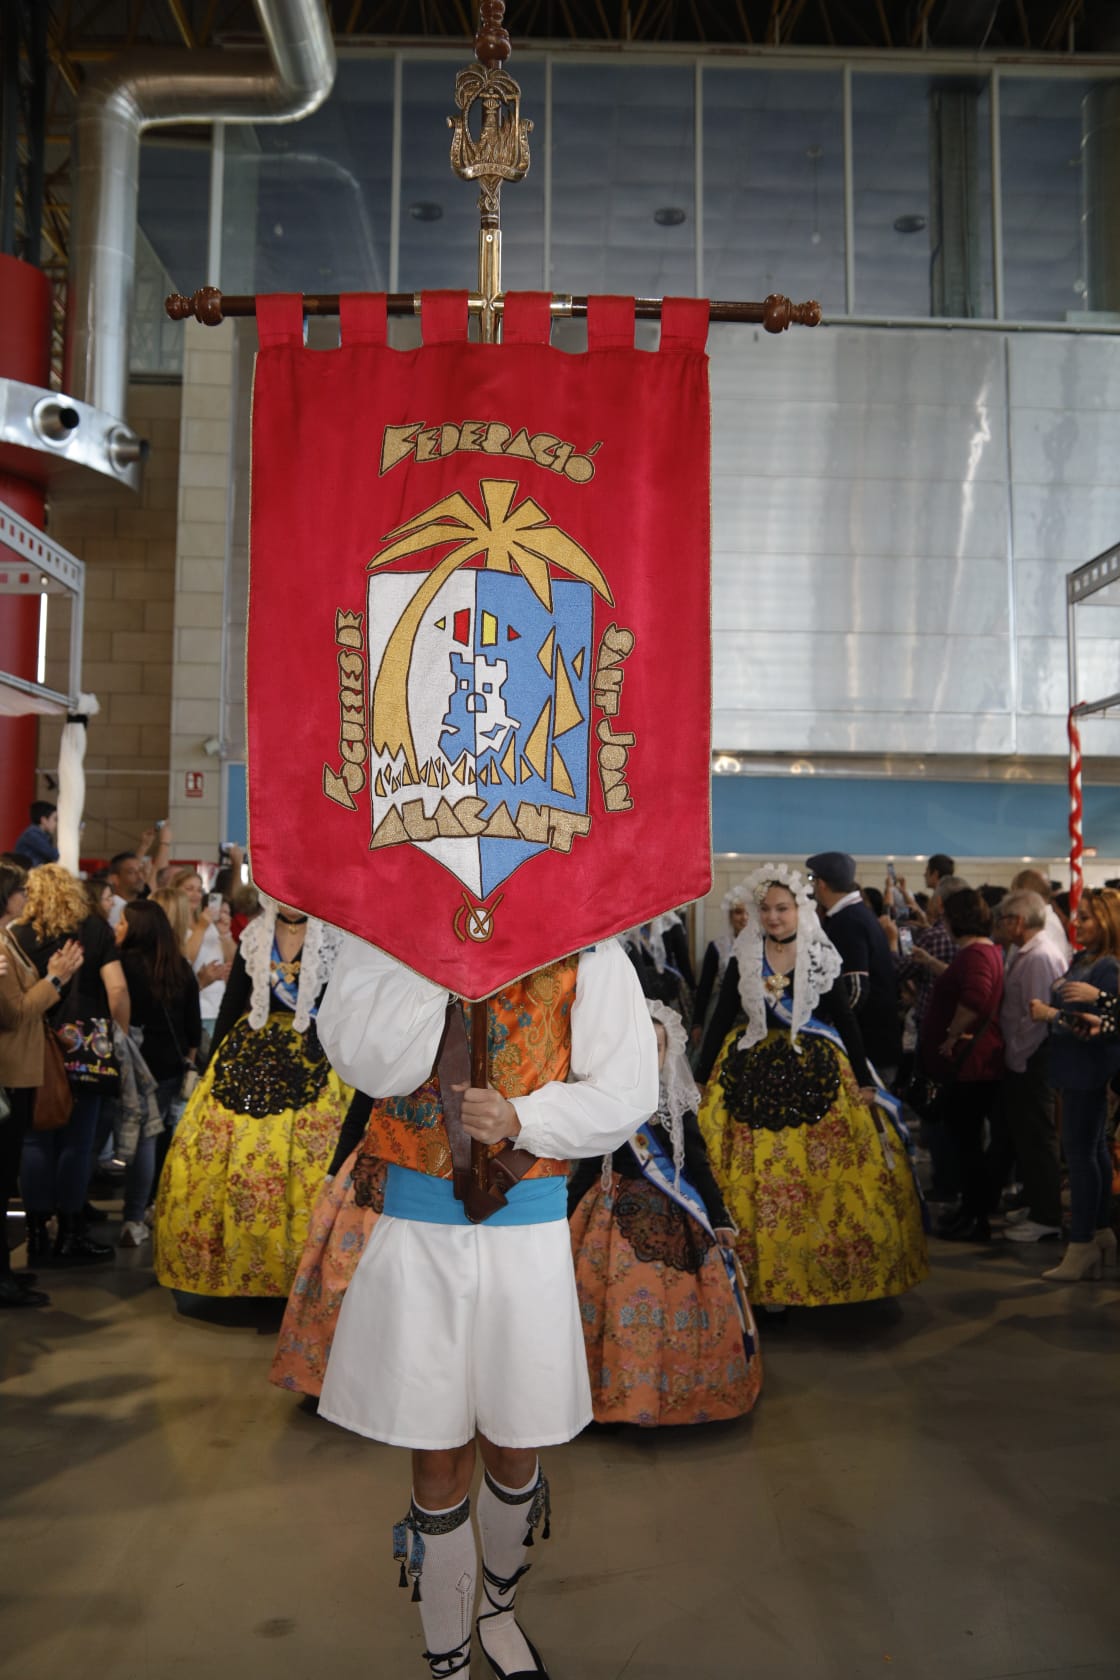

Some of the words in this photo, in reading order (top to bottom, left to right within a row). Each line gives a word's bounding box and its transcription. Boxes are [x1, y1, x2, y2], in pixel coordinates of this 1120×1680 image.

[379, 420, 603, 483] FEDERACIÓ
[335, 608, 364, 650] DE
[593, 622, 635, 716] SANT
[322, 649, 368, 811] FOGUERES
[595, 717, 636, 813] JOAN
[369, 796, 592, 854] ALACANT
